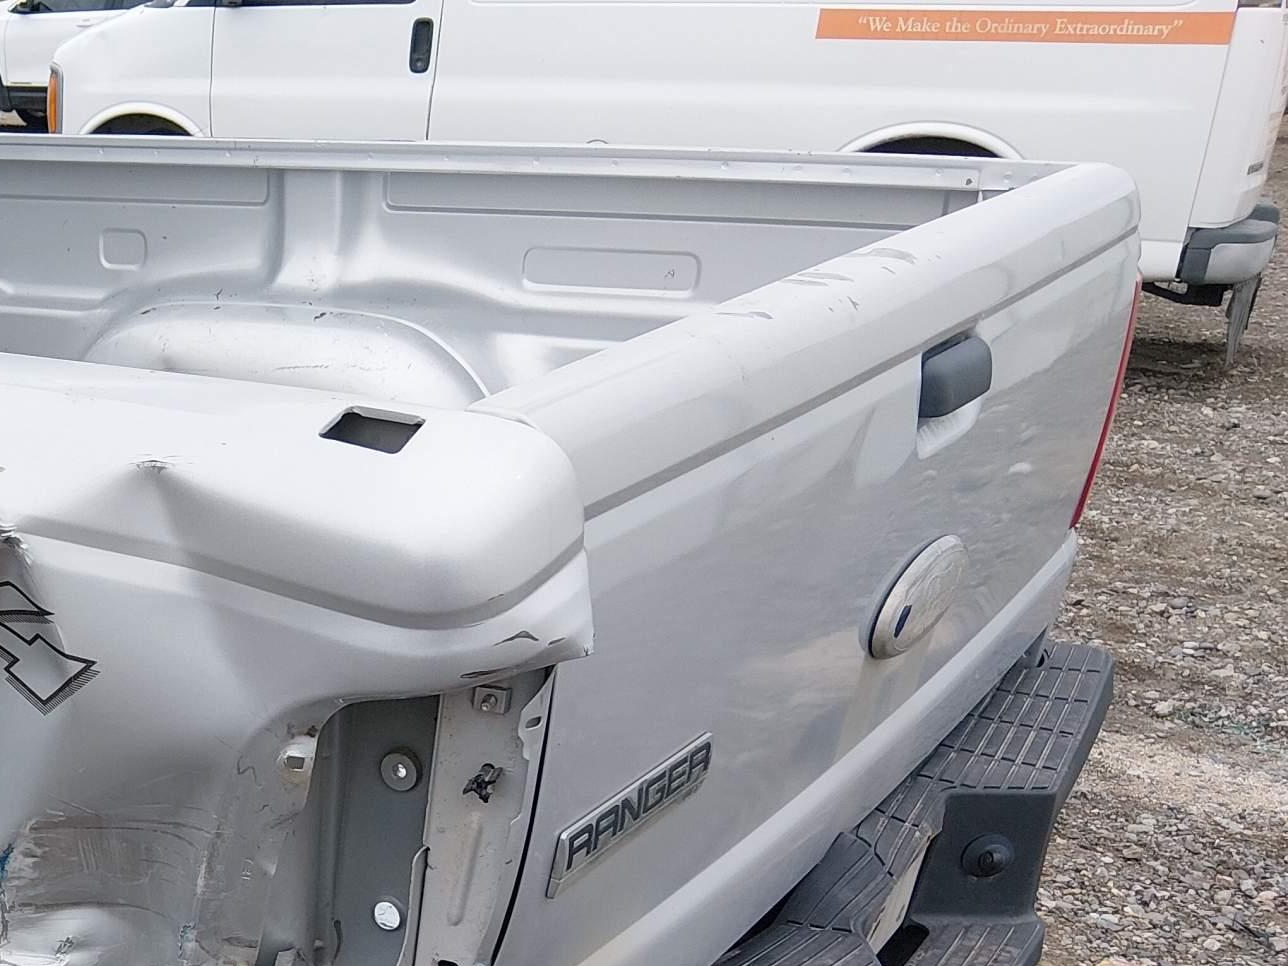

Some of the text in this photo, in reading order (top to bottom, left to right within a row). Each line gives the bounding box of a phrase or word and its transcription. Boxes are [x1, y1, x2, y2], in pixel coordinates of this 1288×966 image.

[858, 15, 1184, 39] “We Make the Ordinary Extraordinary”
[565, 741, 712, 871] RANGER
